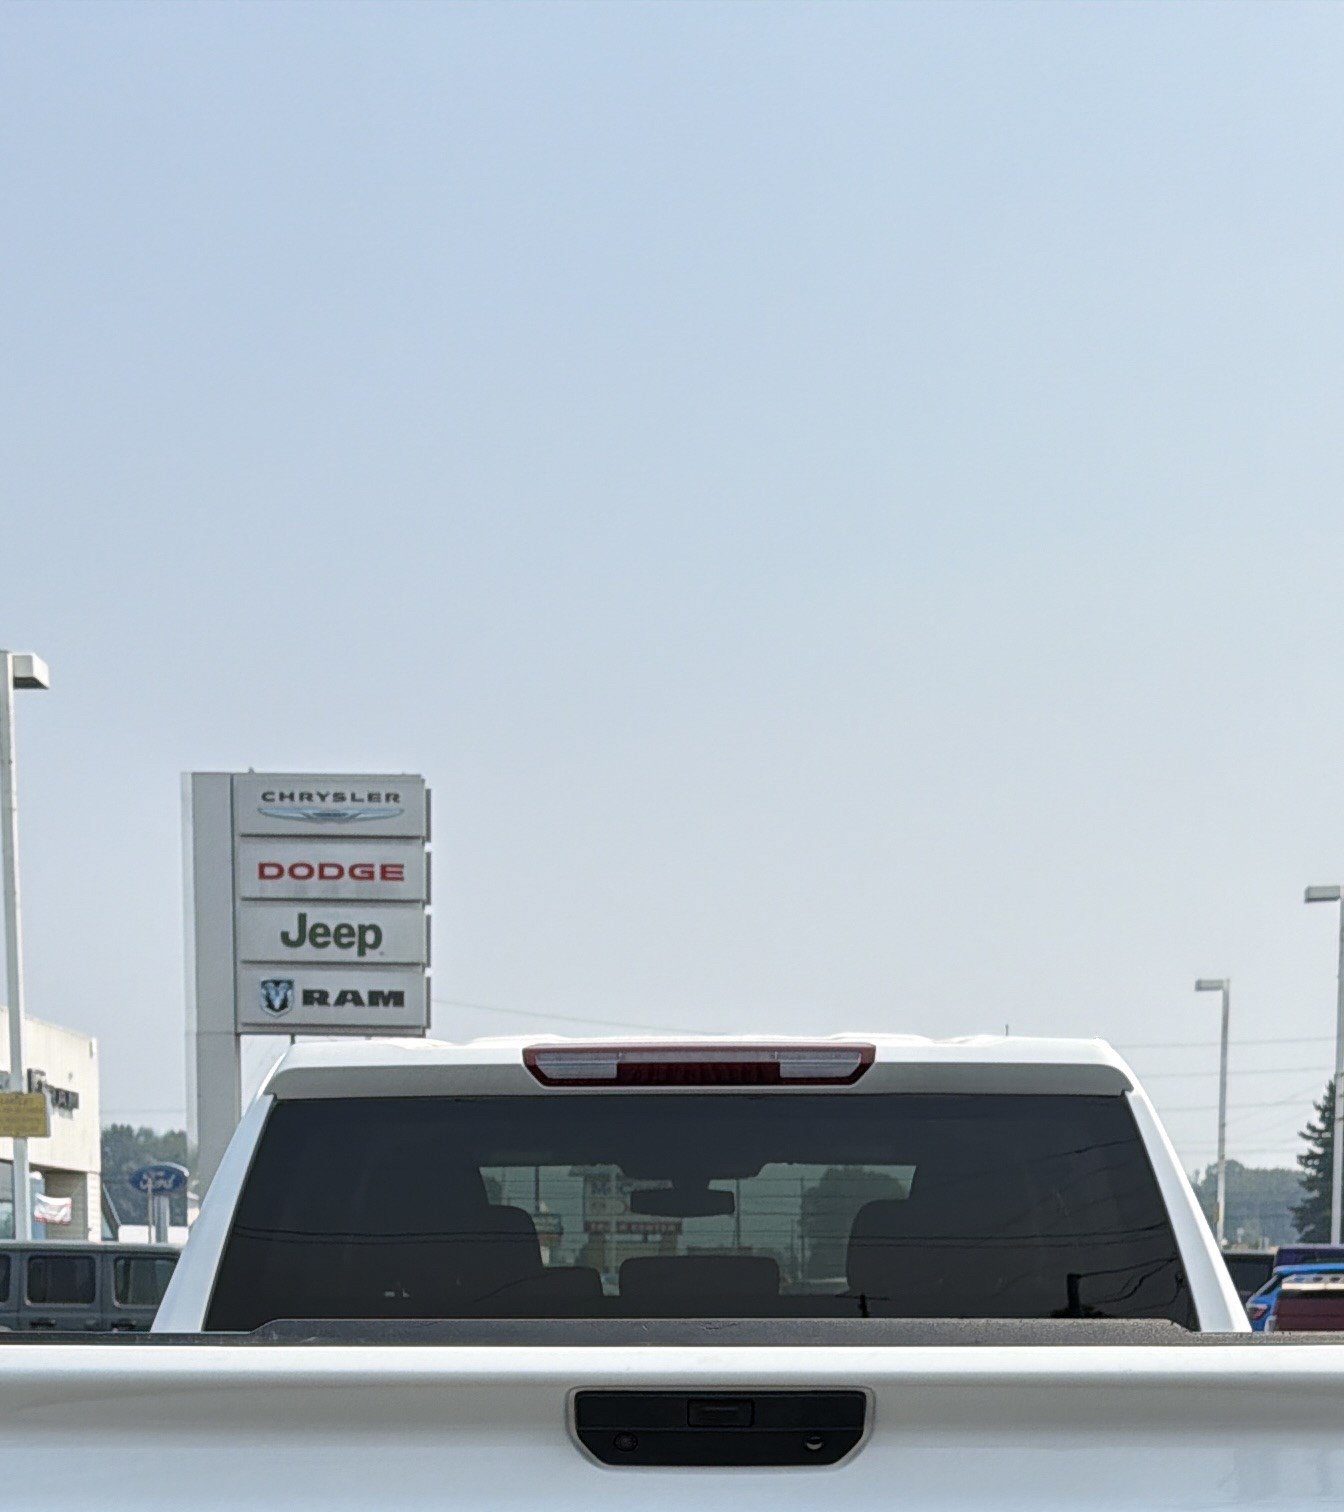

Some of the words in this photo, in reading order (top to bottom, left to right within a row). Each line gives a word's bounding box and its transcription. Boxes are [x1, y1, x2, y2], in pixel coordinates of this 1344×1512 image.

[260, 791, 401, 804] CHRYSLER
[257, 862, 405, 882] DODGE
[280, 912, 383, 957] Jeep
[302, 989, 405, 1008] RAM
